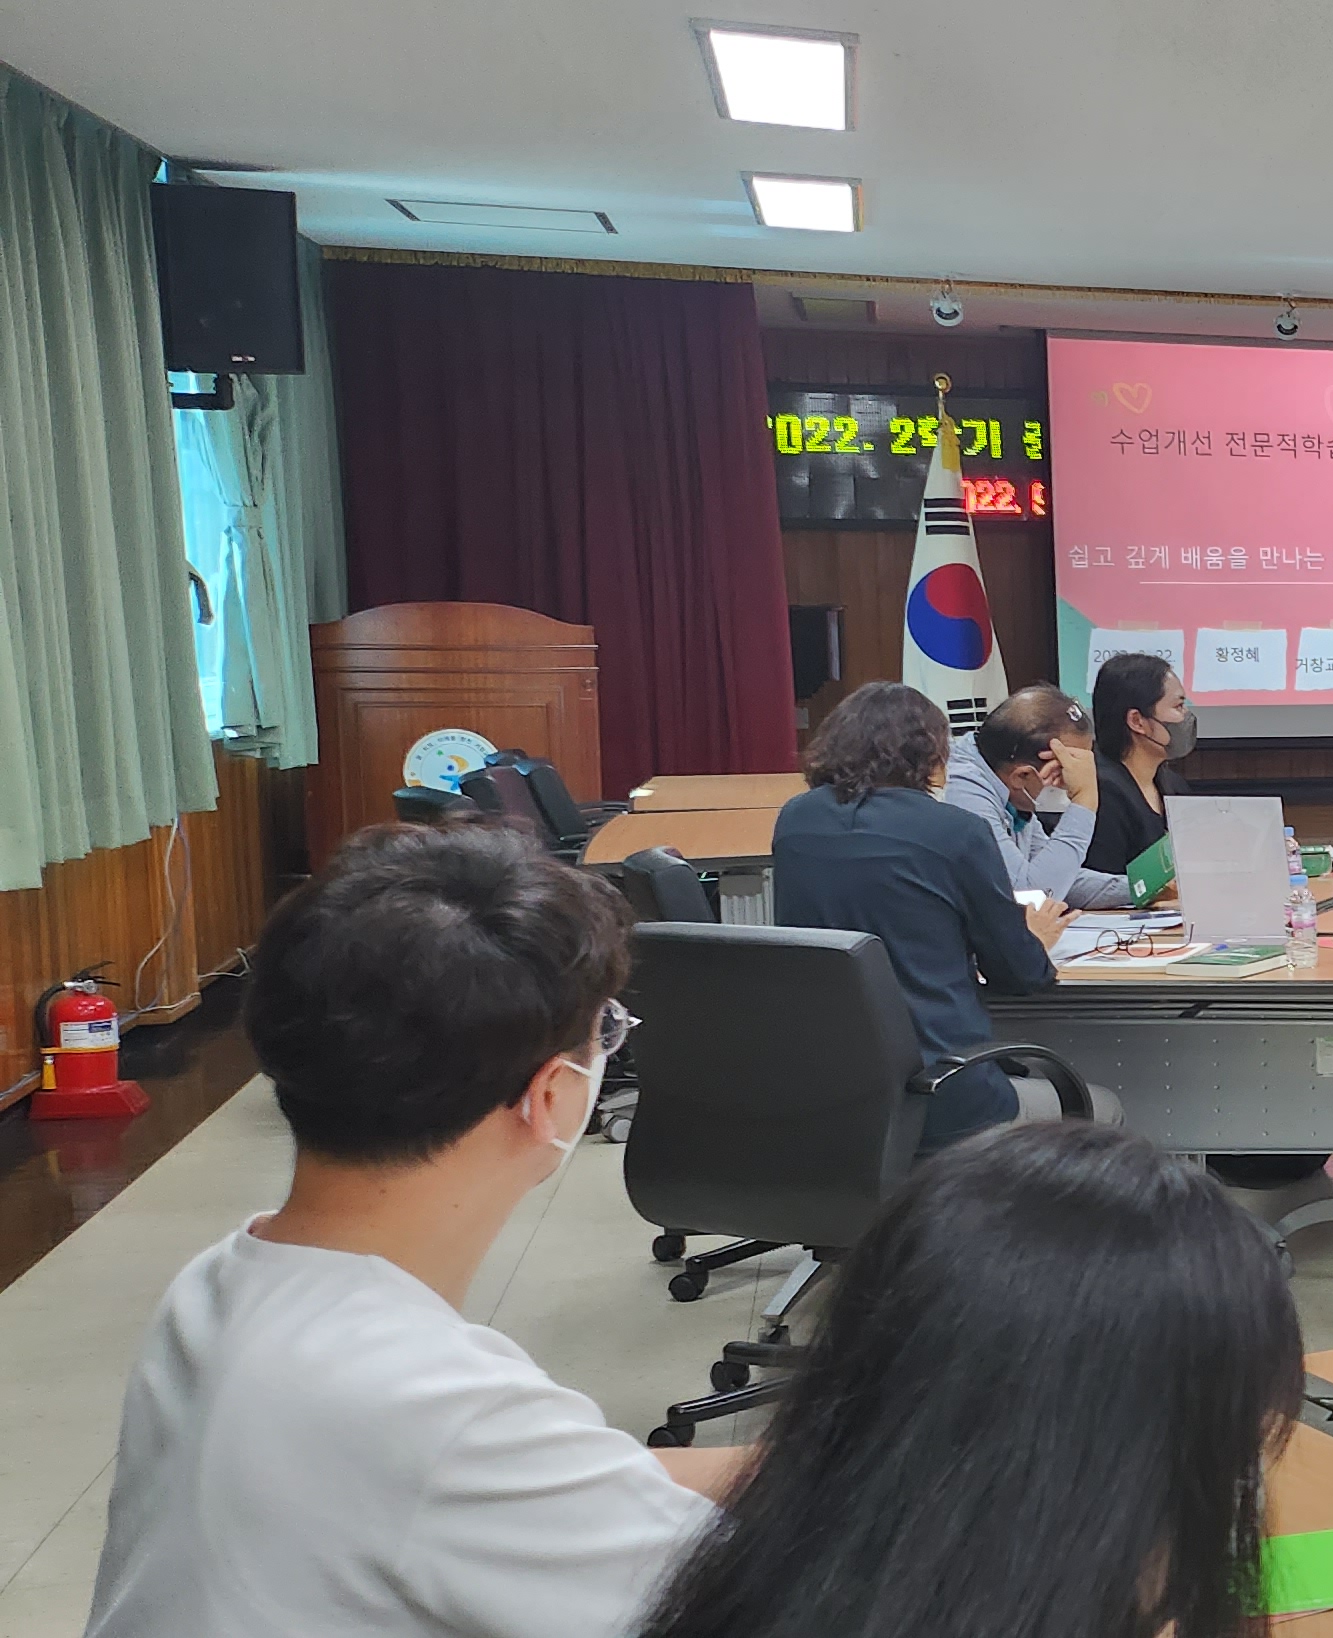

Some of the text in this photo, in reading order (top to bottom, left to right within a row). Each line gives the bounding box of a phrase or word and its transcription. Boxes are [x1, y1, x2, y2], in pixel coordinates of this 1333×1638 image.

[766, 413, 875, 455] 022.
[1109, 427, 1213, 459] 수업개선
[1068, 545, 1116, 570] 쉽고
[1125, 545, 1171, 571] 깊게
[1180, 546, 1250, 573] 배움을
[1259, 547, 1325, 572] 만나는
[1214, 646, 1260, 664] 황정혜
